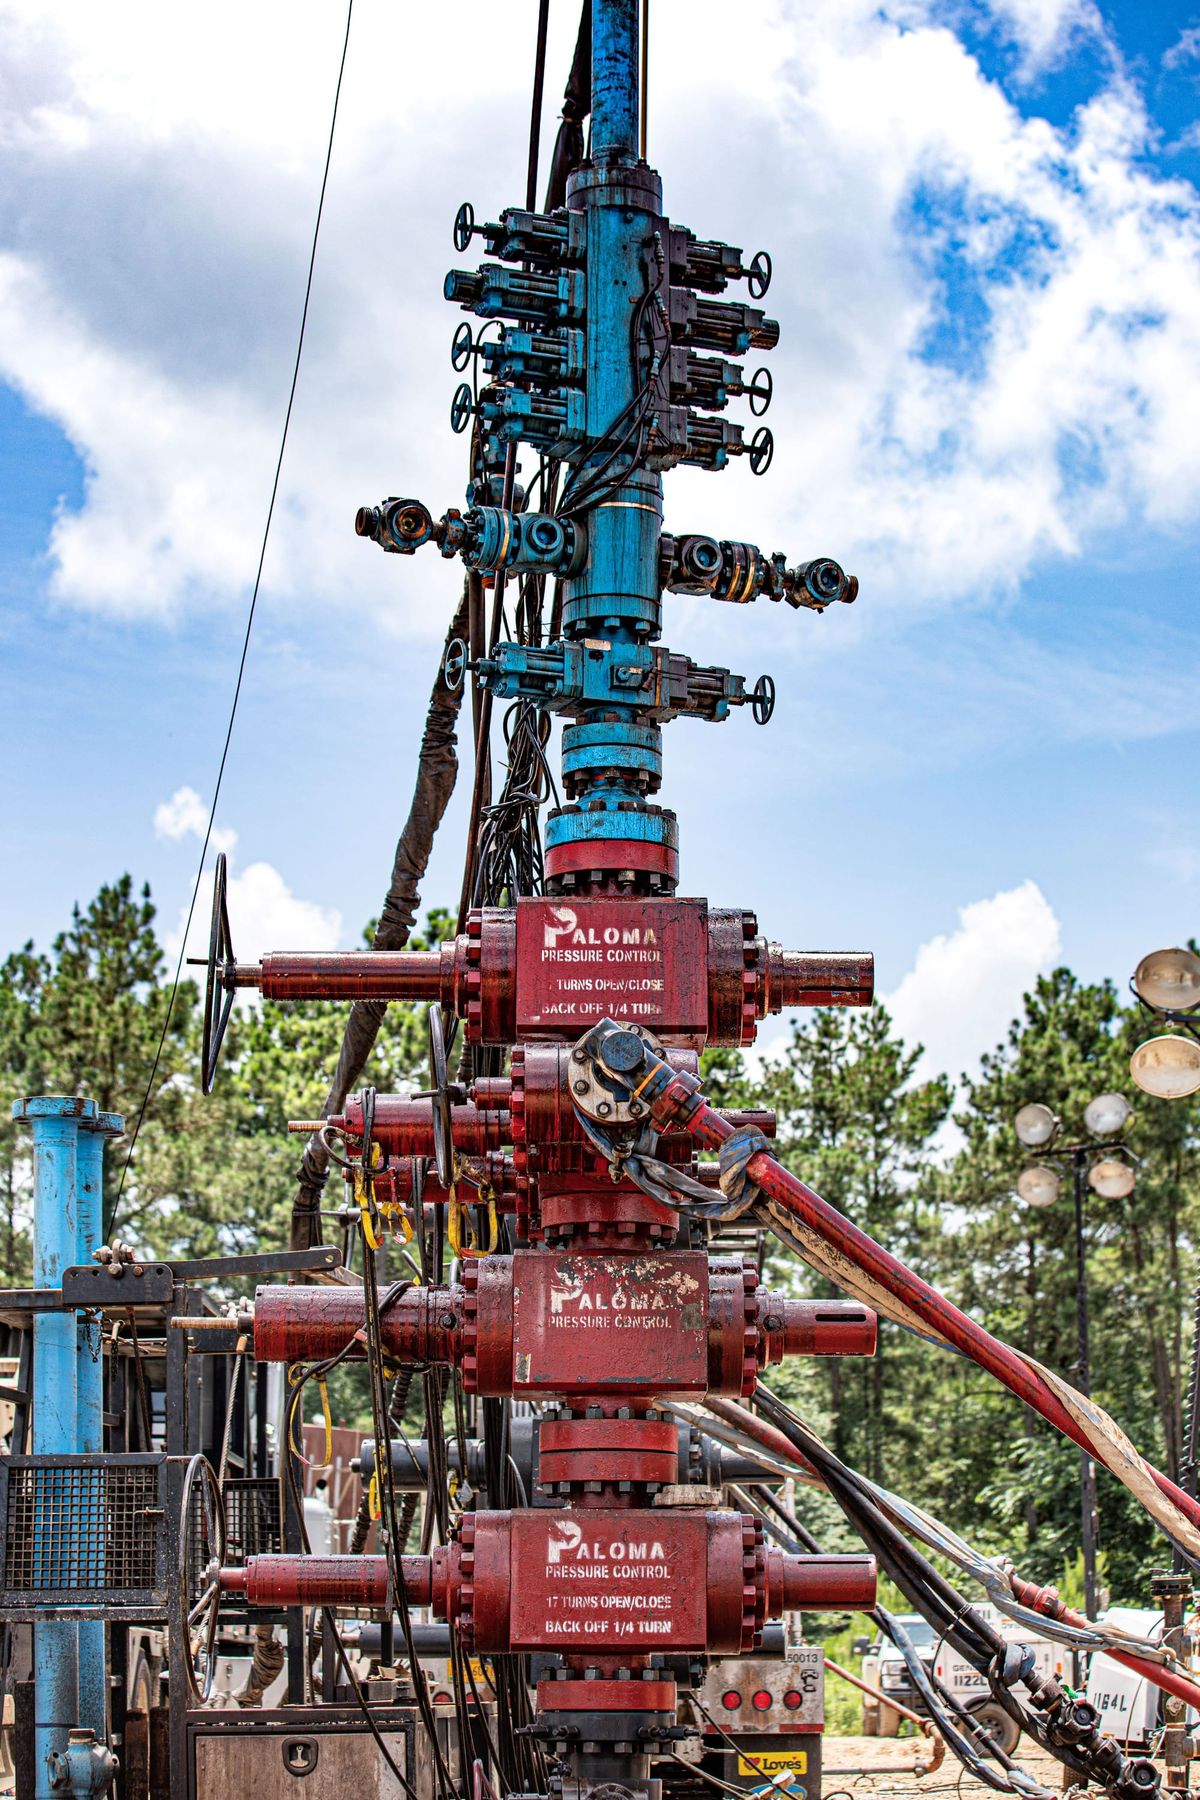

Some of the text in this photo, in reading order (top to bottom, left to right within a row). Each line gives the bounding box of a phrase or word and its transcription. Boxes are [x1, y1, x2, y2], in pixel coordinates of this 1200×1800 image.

[542, 905, 657, 948] PALOMA
[541, 949, 661, 962] PRESSURE CONTROL
[557, 979, 593, 991] TURNS
[595, 979, 665, 993] OPEN/CLOSE
[580, 1003, 604, 1014] OFF
[608, 1003, 628, 1017] 1/4
[550, 1267, 666, 1314] PALOMA
[548, 1314, 672, 1328] PRESSURE CONTROL
[547, 1519, 665, 1563] PALOMA
[545, 1565, 671, 1578] PRESSURE CONTROL
[546, 1596, 559, 1608] 17
[561, 1595, 598, 1608] TURNS
[545, 1620, 672, 1636] BACK OFF 1/4 TURN
[782, 1652, 818, 1663] 50013
[1093, 1692, 1127, 1712] 1164L
[762, 1756, 802, 1770] Love's
